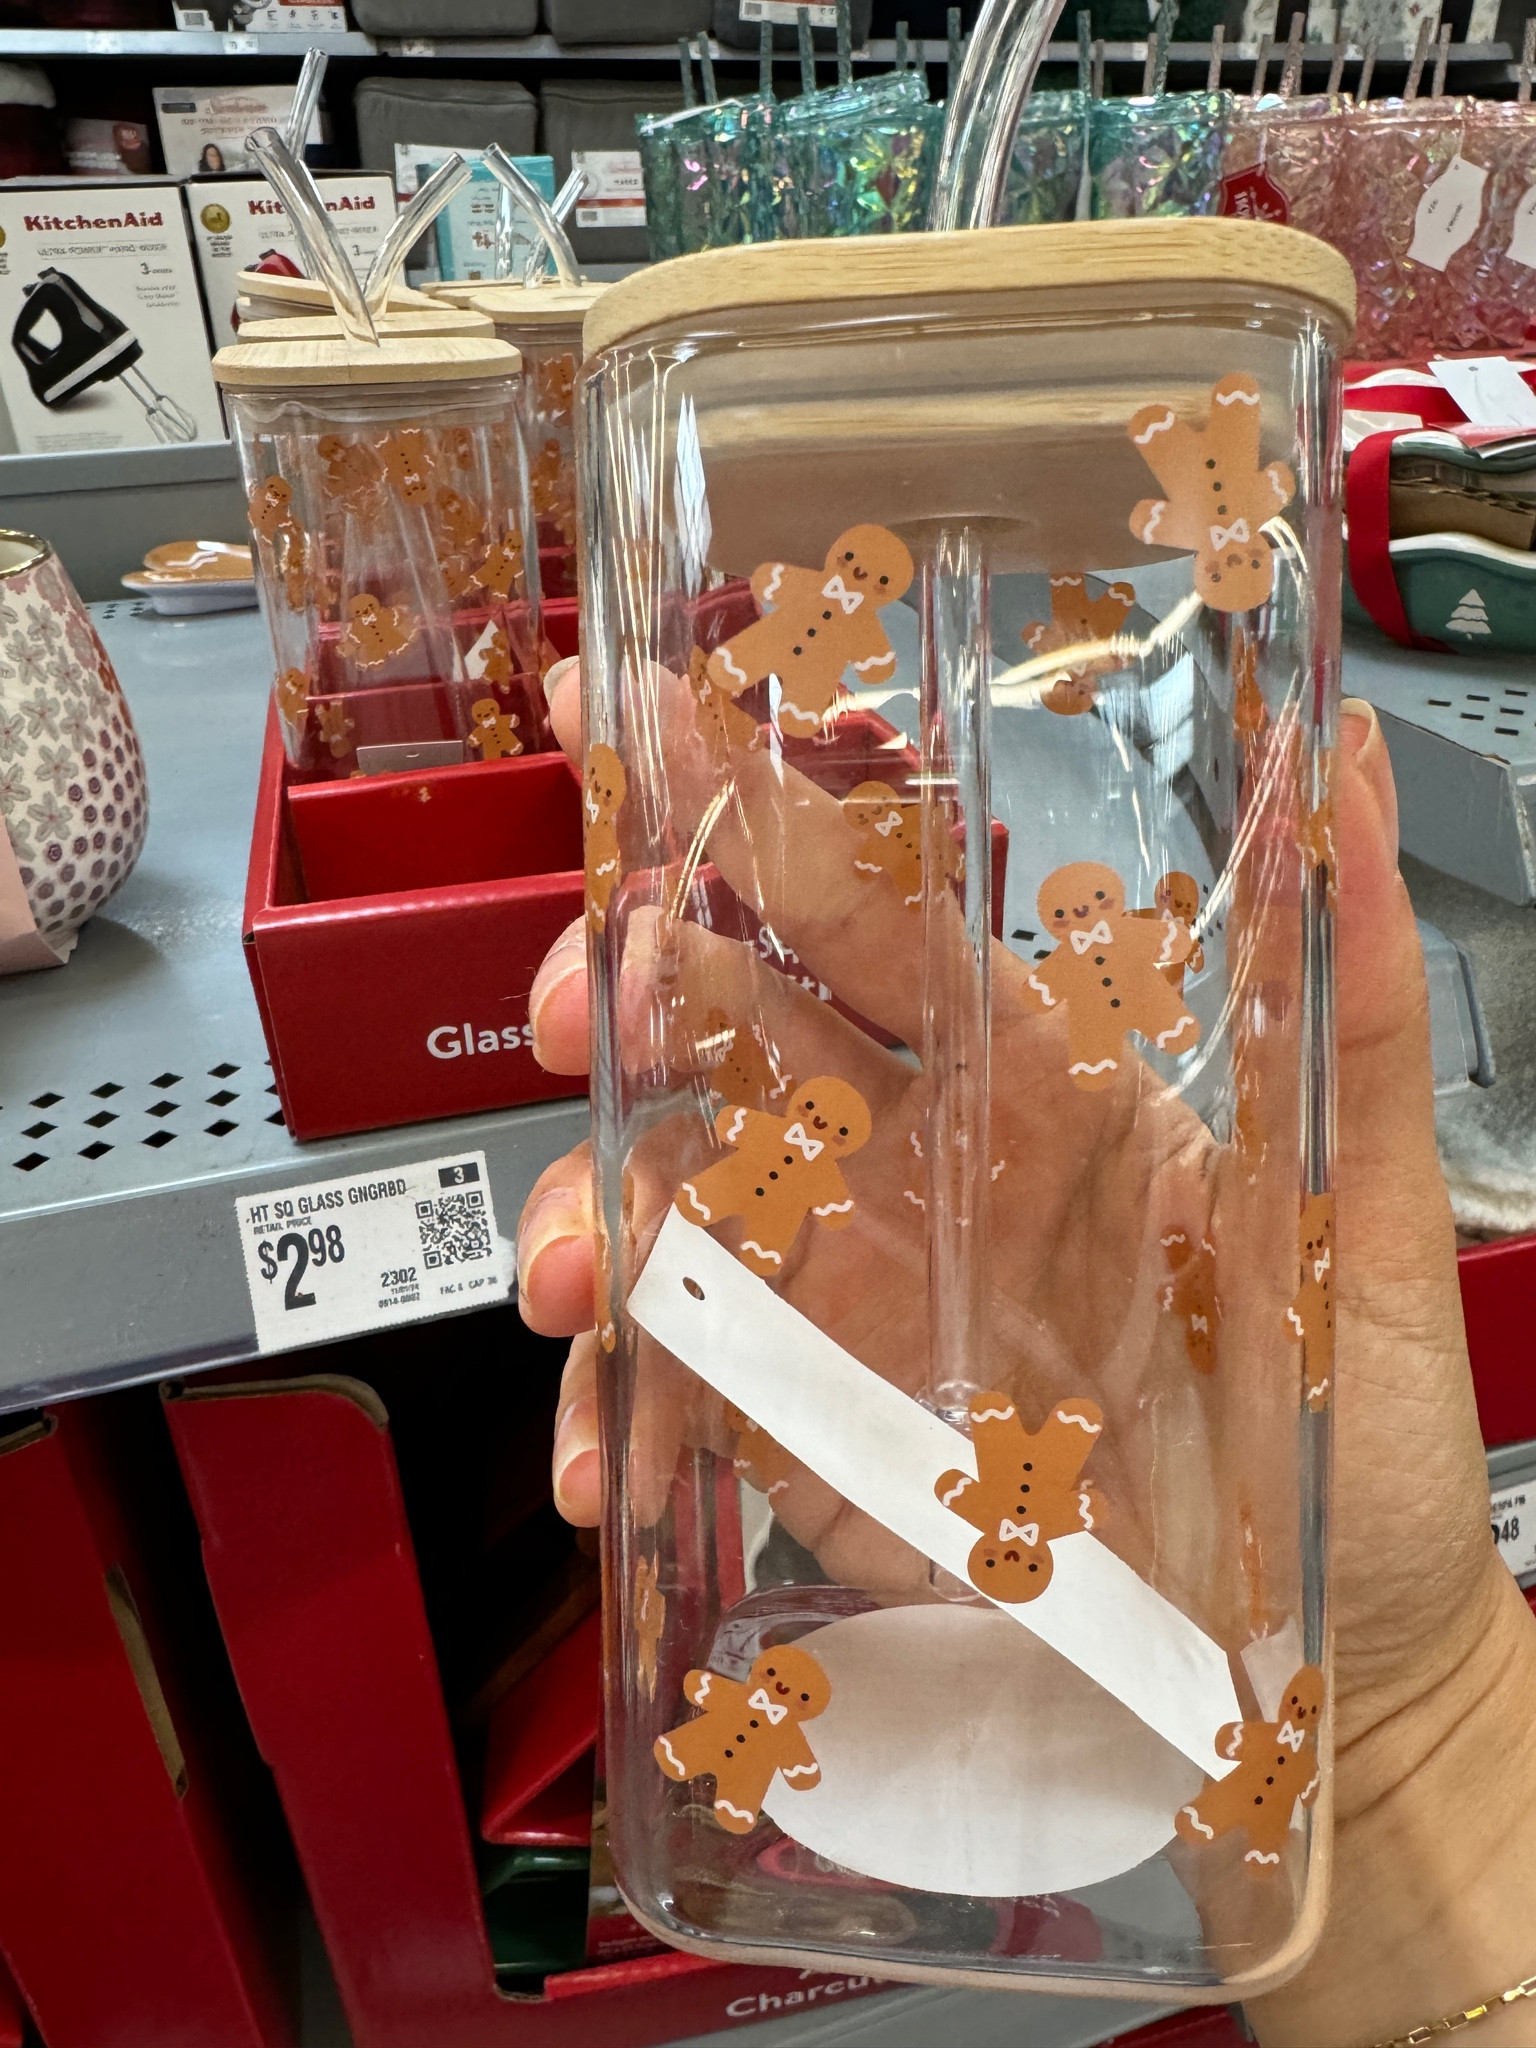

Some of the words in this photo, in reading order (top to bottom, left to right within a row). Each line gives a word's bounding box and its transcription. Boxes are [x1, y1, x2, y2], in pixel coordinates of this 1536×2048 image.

[248, 196, 376, 215] KitnAid
[24, 212, 163, 231] KitchenAid
[426, 1022, 533, 1059] Glass
[453, 1166, 465, 1184] 3
[250, 1204, 269, 1224] HT
[274, 1200, 294, 1219] SQ
[298, 1190, 344, 1214] GLASS
[348, 1178, 408, 1205] GNGRBD
[380, 1267, 417, 1288] 2302
